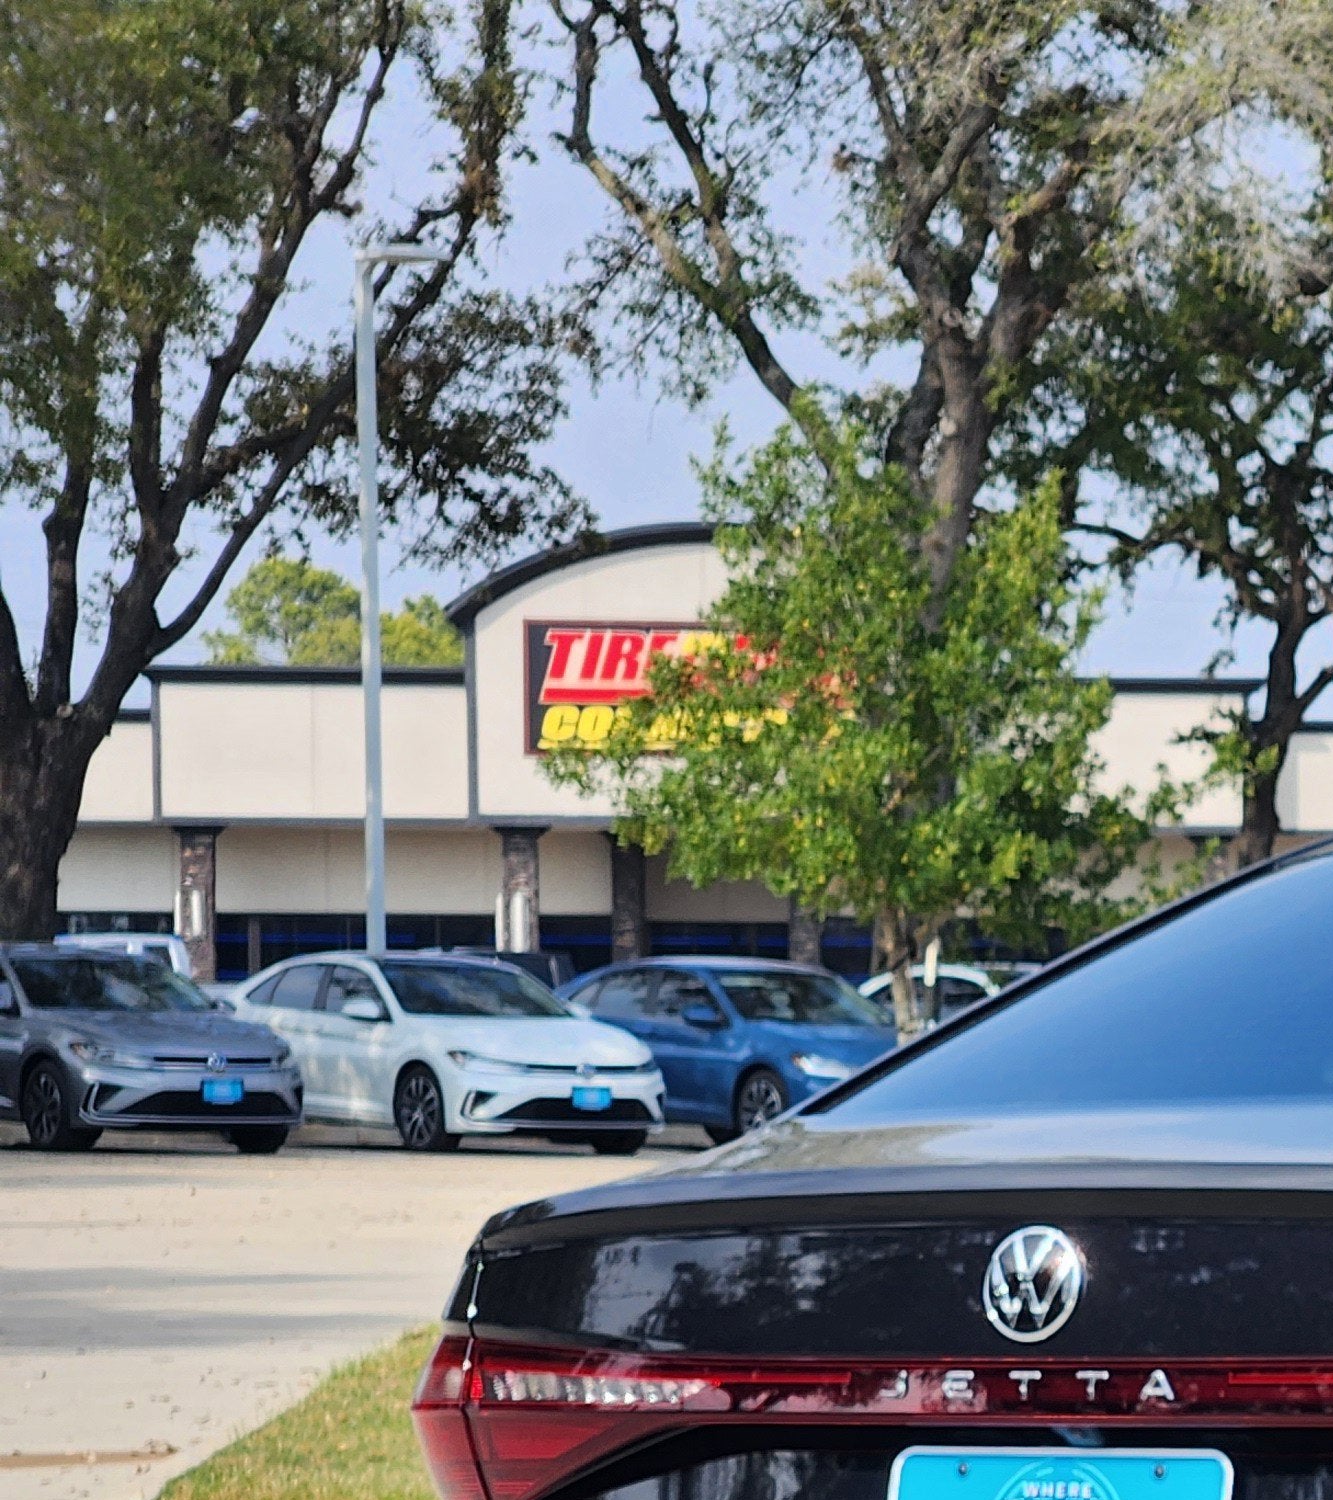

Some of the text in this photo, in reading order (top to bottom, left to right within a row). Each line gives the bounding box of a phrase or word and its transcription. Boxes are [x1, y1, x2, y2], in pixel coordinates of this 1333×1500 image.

[982, 1225, 1081, 1343] VW
[878, 1368, 1175, 1401] JETTA
[1022, 1480, 1093, 1499] WHERE
